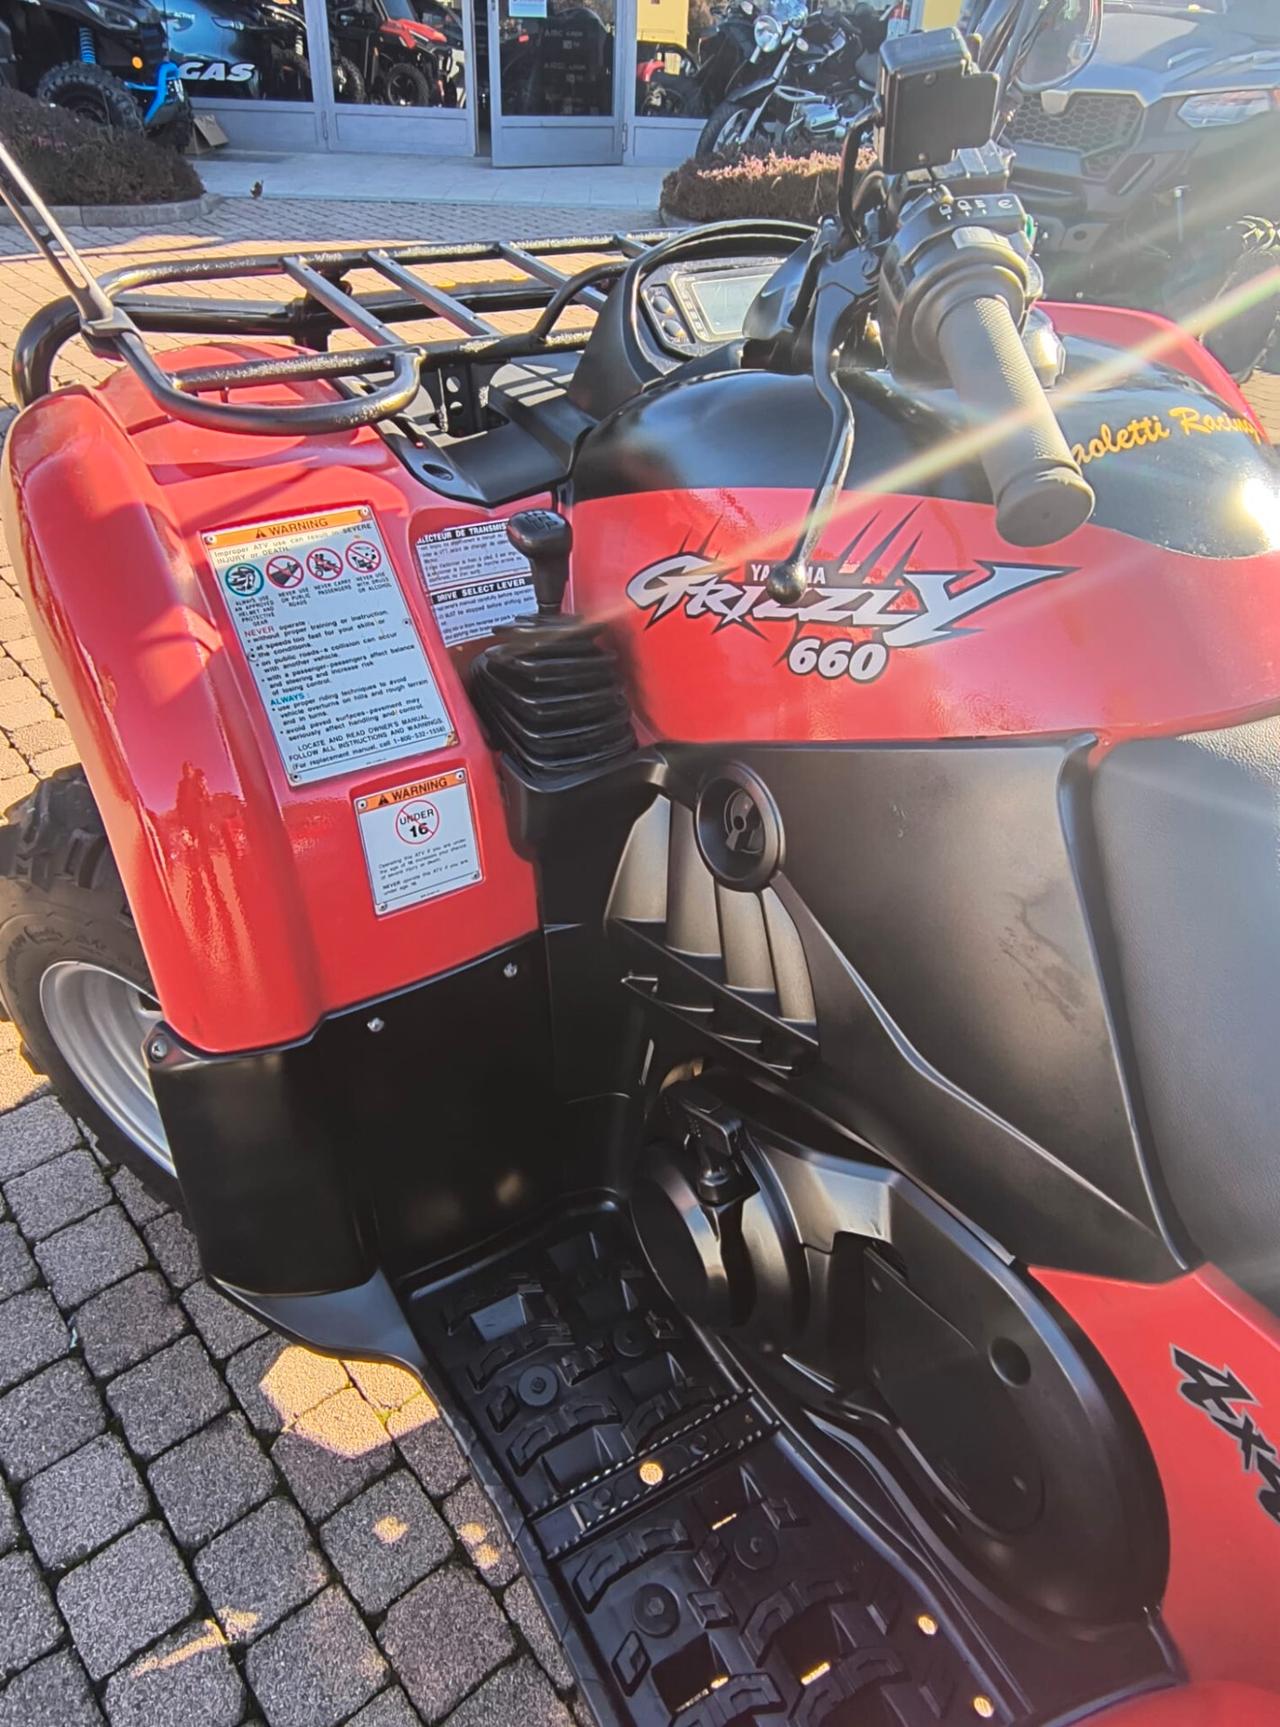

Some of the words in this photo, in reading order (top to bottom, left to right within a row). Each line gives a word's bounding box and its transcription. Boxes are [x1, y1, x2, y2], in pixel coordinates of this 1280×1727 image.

[179, 62, 255, 81] GAS
[1070, 415, 1169, 464] aoletti
[1168, 406, 1262, 445] Racing
[269, 518, 328, 535] WARNING
[343, 523, 372, 533] SEVERE
[456, 529, 465, 537] DE
[217, 554, 245, 564] INJURY
[318, 585, 351, 595] PASSENGERS
[437, 591, 457, 602] DRIVE
[462, 584, 494, 596] SELECT
[497, 579, 525, 589] LEVER
[628, 553, 1078, 648] GRIZZLY
[242, 612, 275, 622] PROTECTIVE
[244, 626, 274, 637] NEVER
[284, 628, 306, 637] proper
[310, 621, 337, 630] training
[266, 640, 291, 649] speeds
[390, 645, 415, 653] balance
[274, 655, 296, 664] public
[283, 660, 309, 669] another
[786, 637, 889, 684] 660
[286, 675, 313, 685] steering
[331, 665, 358, 674] increase
[294, 699, 315, 708] proper
[319, 693, 339, 701] riding
[341, 685, 377, 696] techniques
[390, 676, 407, 685] avoid
[281, 709, 304, 718] vehicle
[308, 701, 339, 712] overturns
[386, 685, 405, 693] rough
[286, 725, 306, 734] avoid
[310, 719, 331, 729] paved
[289, 730, 321, 741] seriously
[326, 723, 345, 732] affect
[348, 716, 379, 726] handling
[298, 740, 325, 751] LOCATE
[329, 735, 343, 743] AND
[346, 730, 365, 739] READ
[368, 721, 399, 733] OWNER'S
[289, 750, 318, 761] FOLLOW
[338, 732, 387, 749] INSTRUCTIONS
[310, 751, 349, 765] replacement
[379, 740, 391, 748] call
[392, 778, 447, 800] WARNING
[400, 809, 434, 825] UNDER
[410, 823, 429, 837] 16
